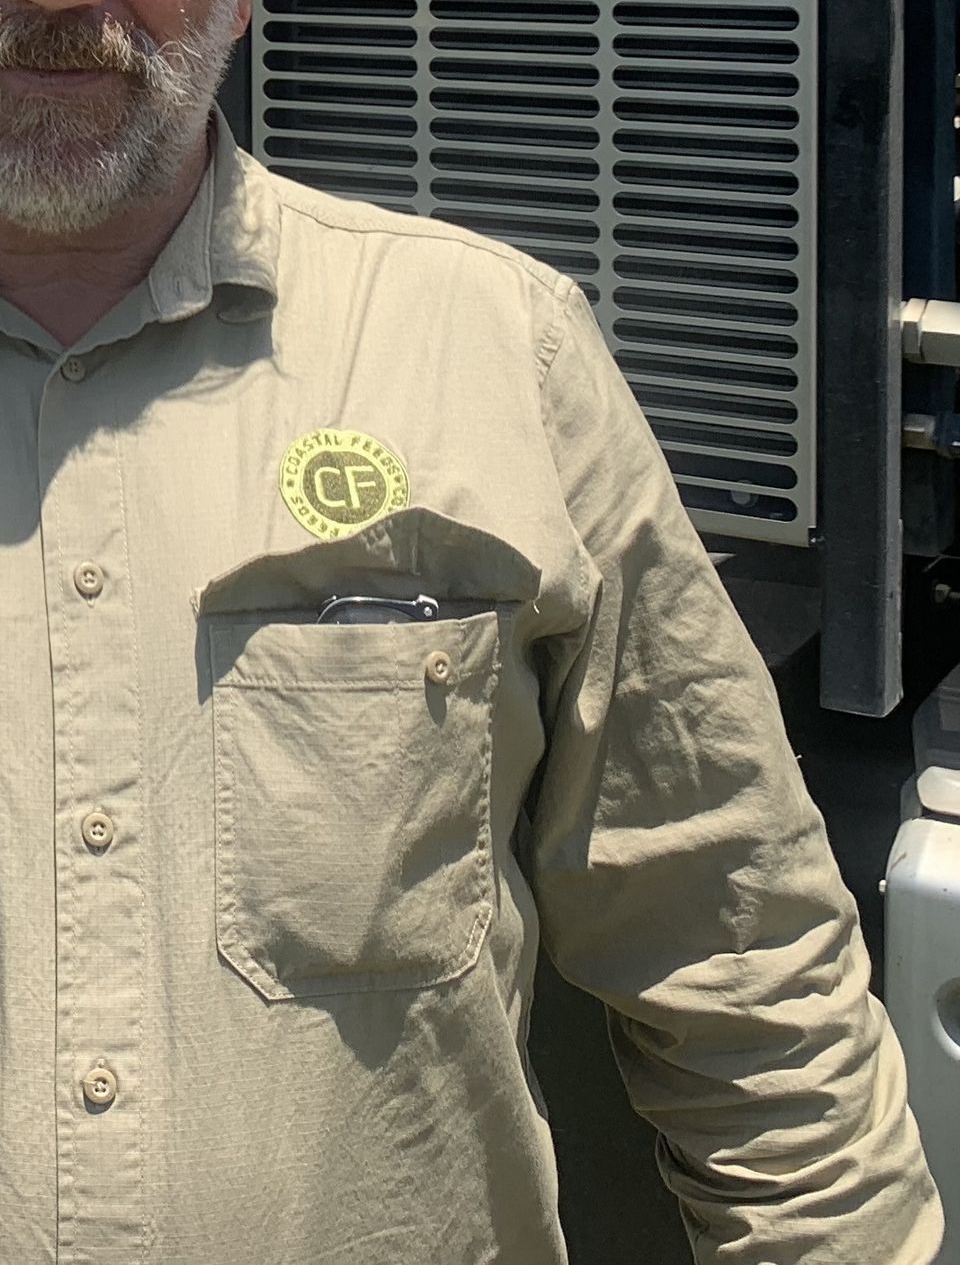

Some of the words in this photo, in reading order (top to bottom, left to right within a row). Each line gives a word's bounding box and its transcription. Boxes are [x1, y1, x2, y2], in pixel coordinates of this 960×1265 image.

[286, 434, 342, 474] COASTAL
[350, 436, 401, 475] FEEDS
[314, 465, 377, 509] CF
